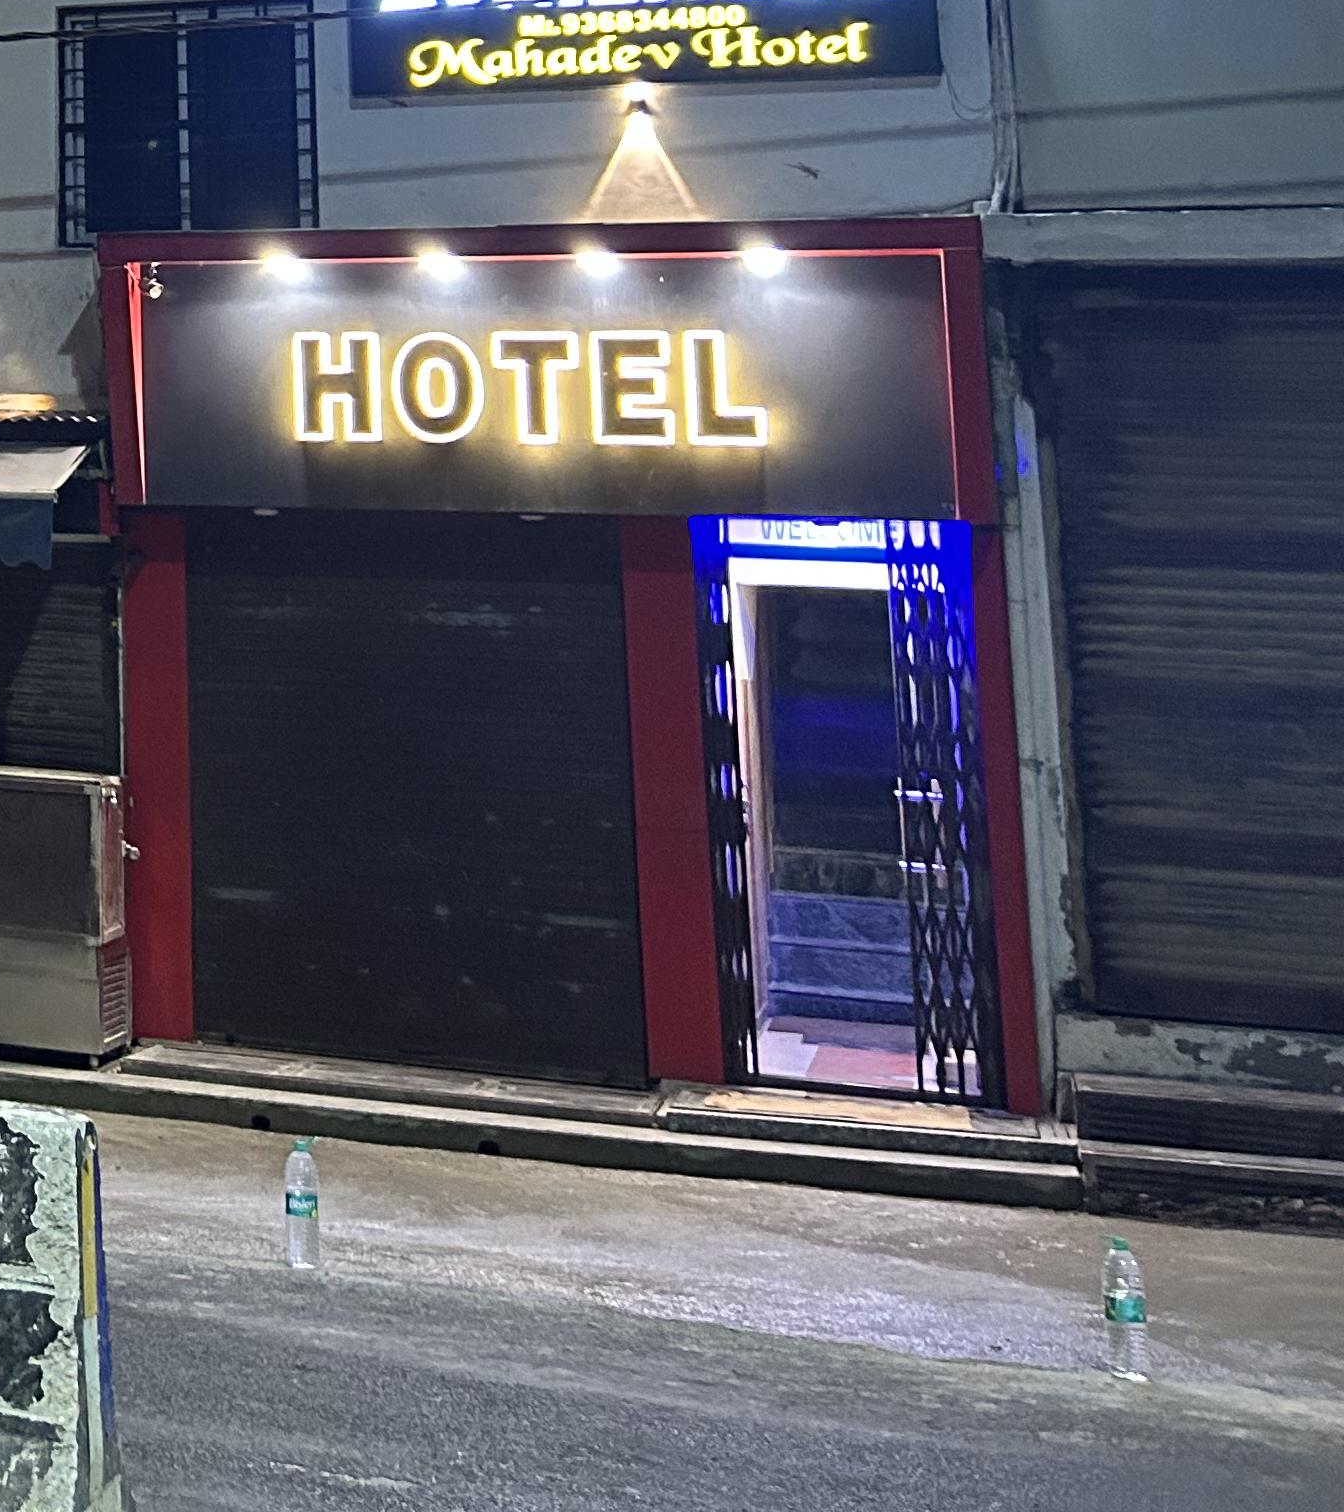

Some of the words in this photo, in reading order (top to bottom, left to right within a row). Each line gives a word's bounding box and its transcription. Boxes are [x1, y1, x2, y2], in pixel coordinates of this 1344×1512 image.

[409, 34, 681, 88] Mahadev
[691, 21, 870, 69] Hotel
[290, 328, 769, 447] HOTEL
